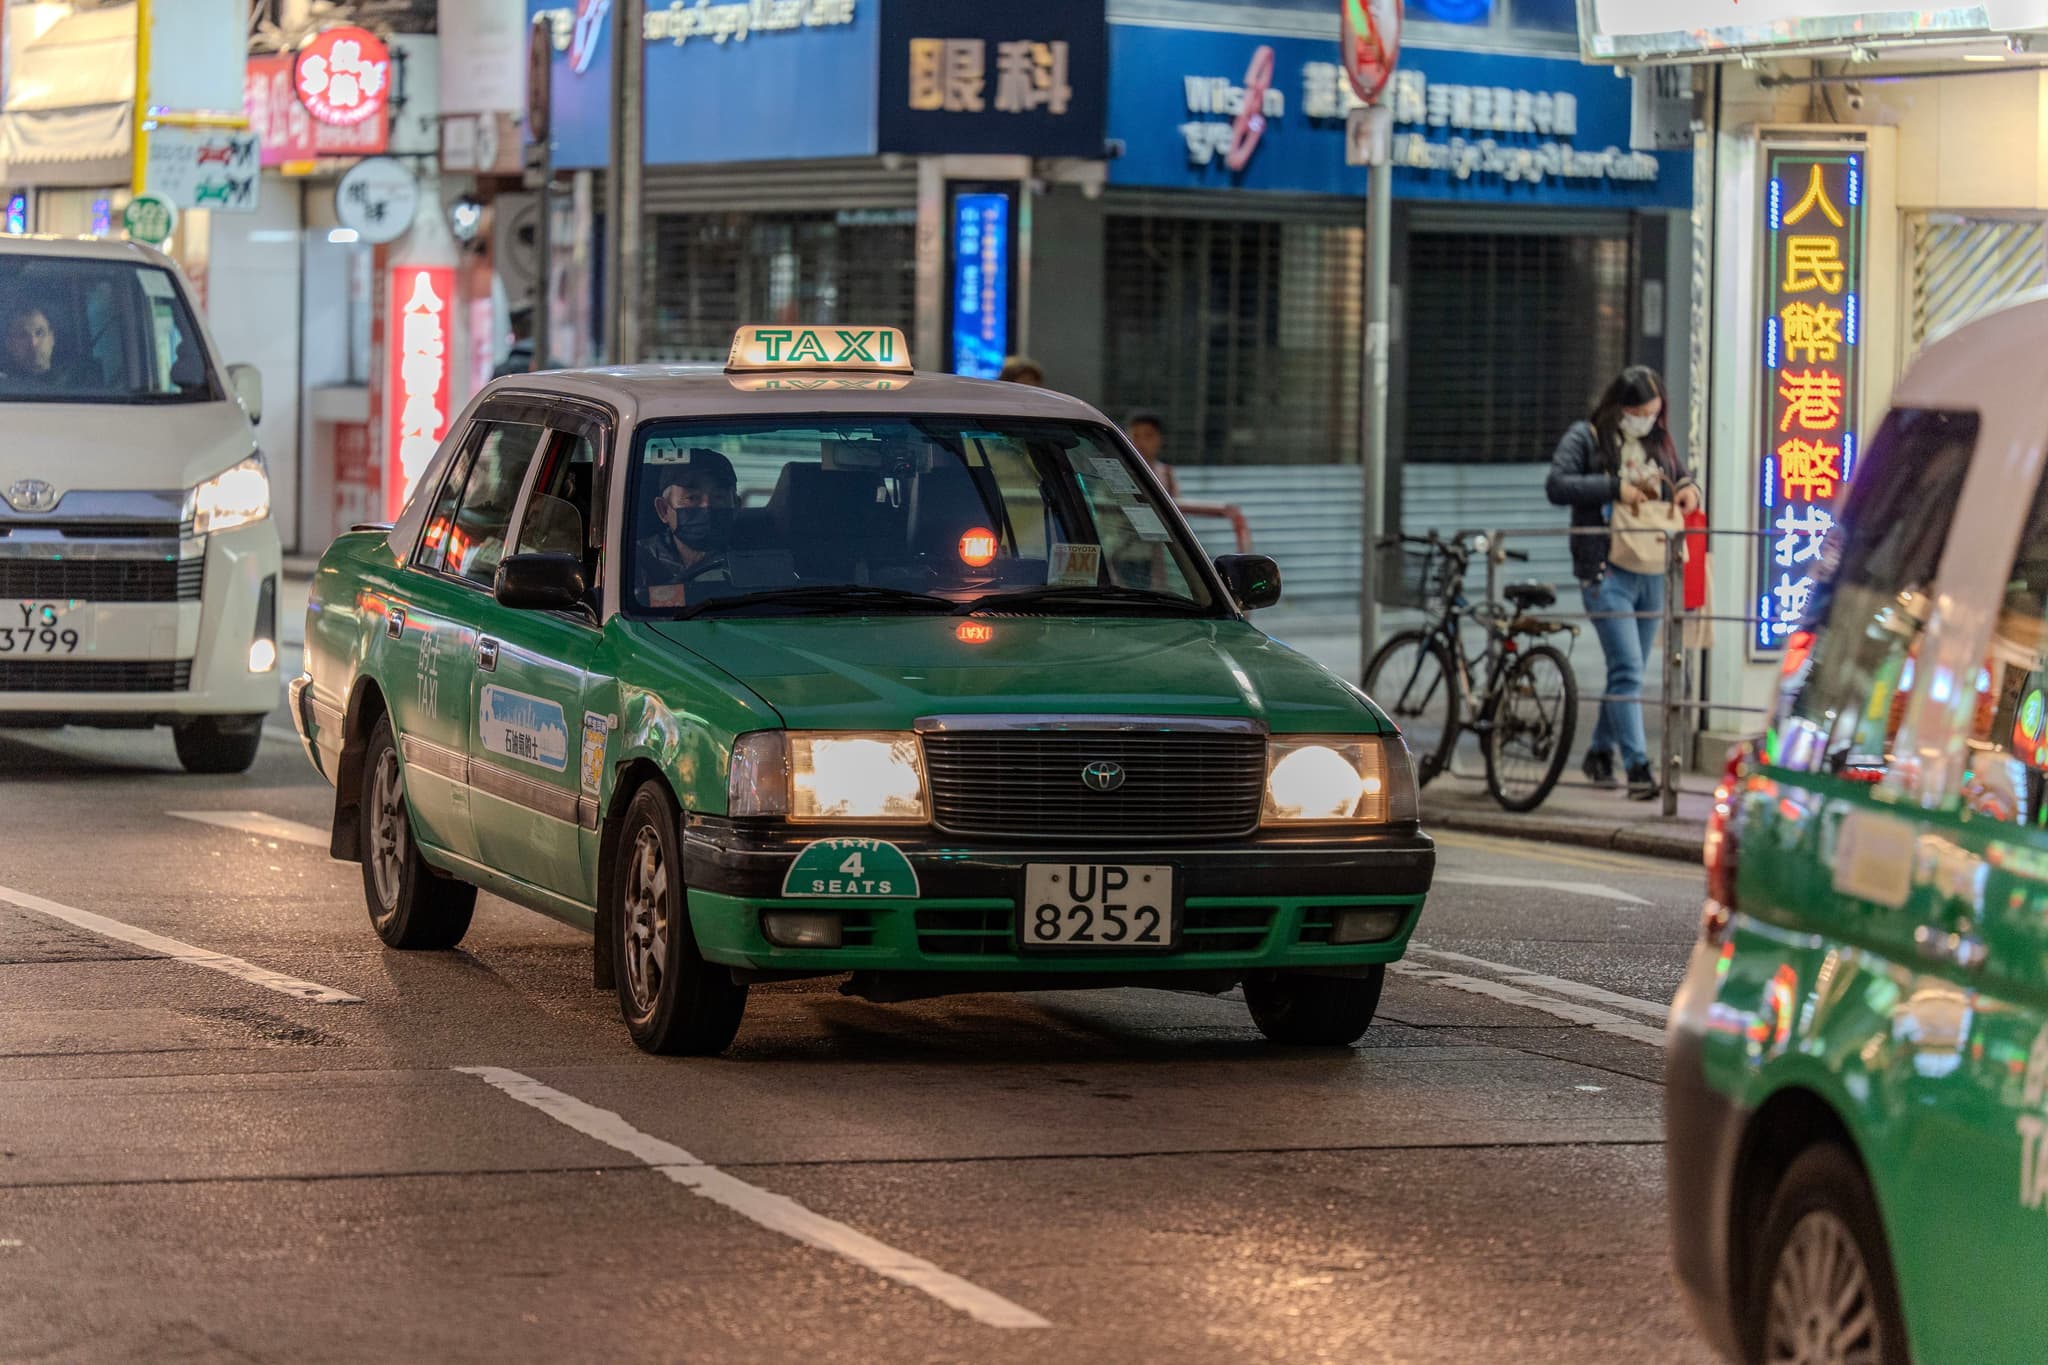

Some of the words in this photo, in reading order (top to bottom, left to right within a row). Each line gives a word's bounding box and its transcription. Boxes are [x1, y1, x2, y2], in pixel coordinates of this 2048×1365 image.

[908, 37, 1073, 115] 眼科
[755, 330, 893, 362] TAXI
[962, 537, 994, 557] TAXI
[1055, 552, 1097, 572] TAXI
[19, 603, 57, 627] YS
[0, 627, 79, 653] 3799
[418, 631, 441, 677] 的士
[416, 672, 438, 721] TAXI
[505, 728, 539, 761] 石油氣的士
[825, 839, 881, 852] TAXI
[839, 852, 865, 878] 4
[812, 879, 892, 894] SEATS
[1068, 866, 1129, 904] UP
[1034, 903, 1161, 943] 8252
